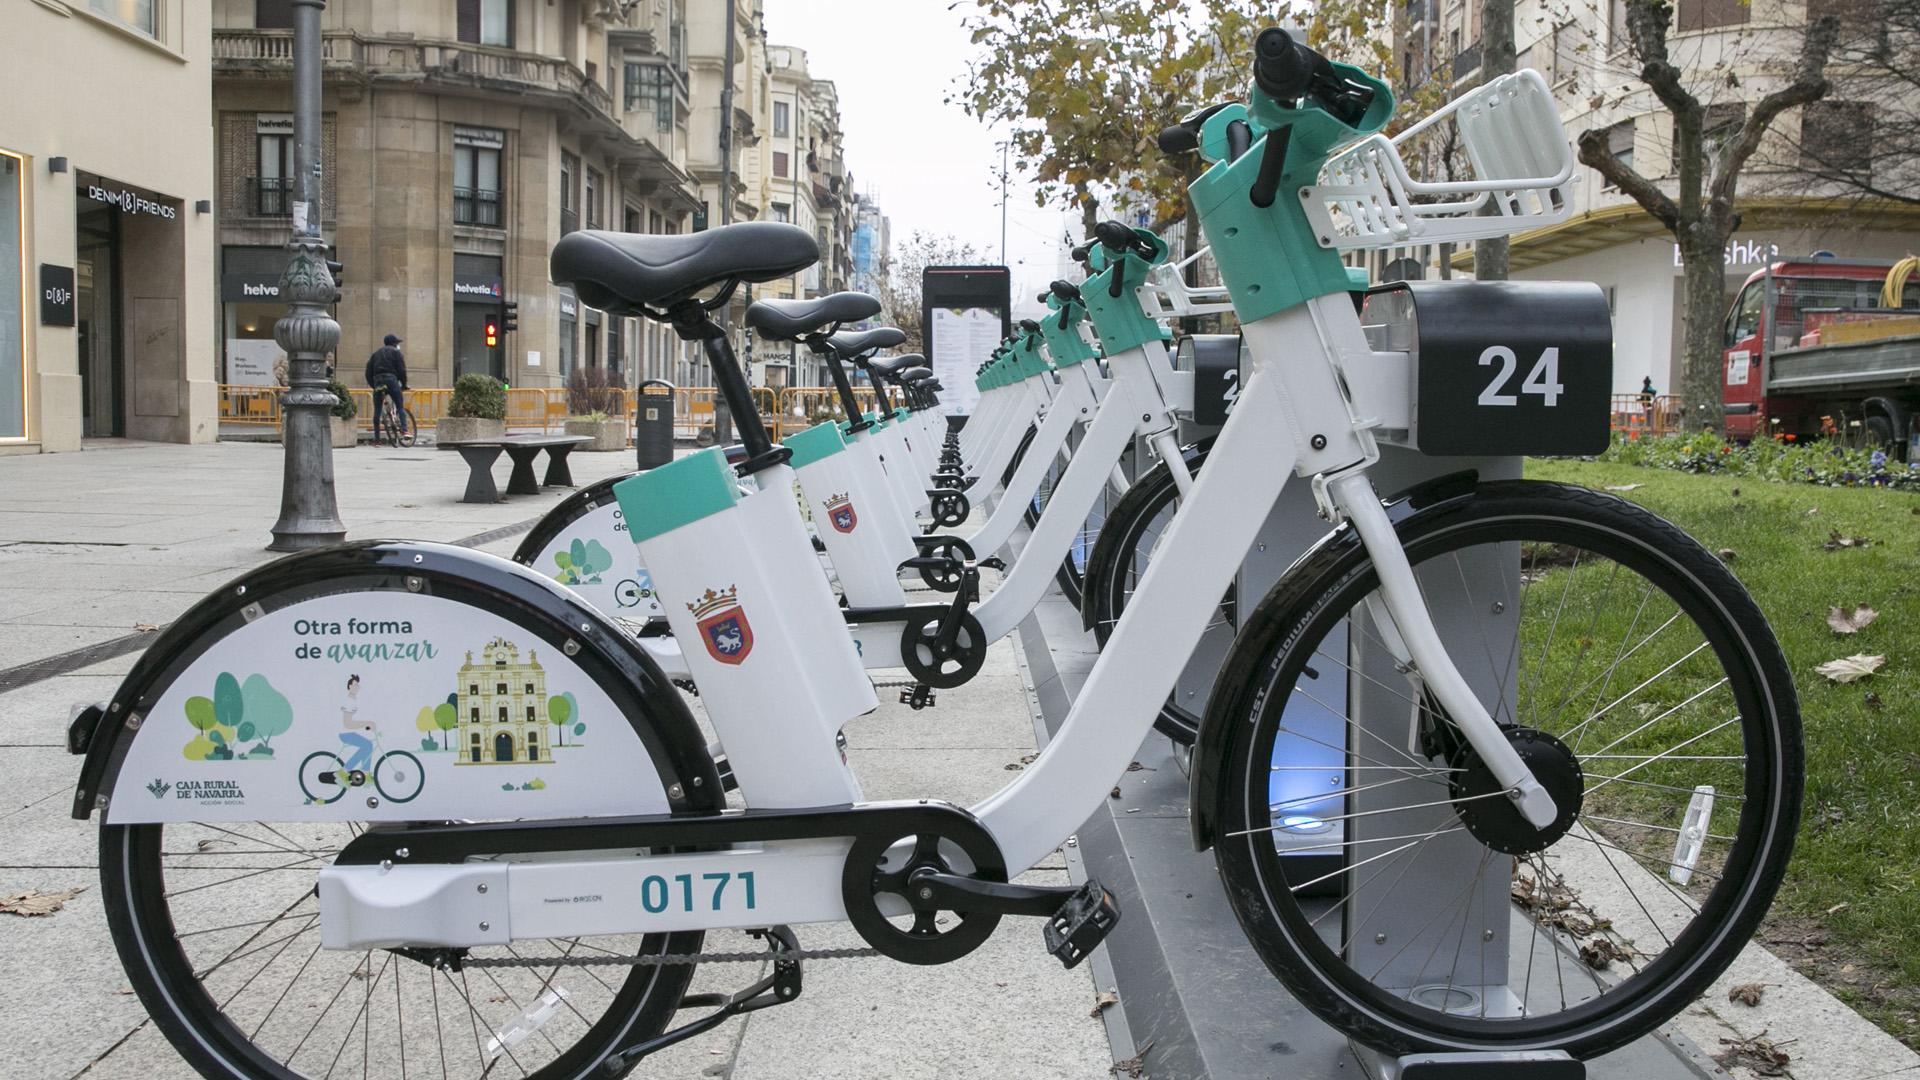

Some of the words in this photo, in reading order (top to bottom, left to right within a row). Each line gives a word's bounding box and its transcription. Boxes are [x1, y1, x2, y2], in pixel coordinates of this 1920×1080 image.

[455, 283, 491, 295] helvetia
[1478, 345, 1564, 407] 24
[294, 619, 342, 636] Otra
[347, 617, 413, 635] forma
[295, 642, 322, 660] de
[327, 639, 439, 664] avanzar
[176, 780, 202, 790] CAJA
[204, 780, 240, 790] RURAL
[177, 790, 192, 799] DE
[194, 789, 245, 799] NAVARRA
[641, 871, 755, 914] 0171
